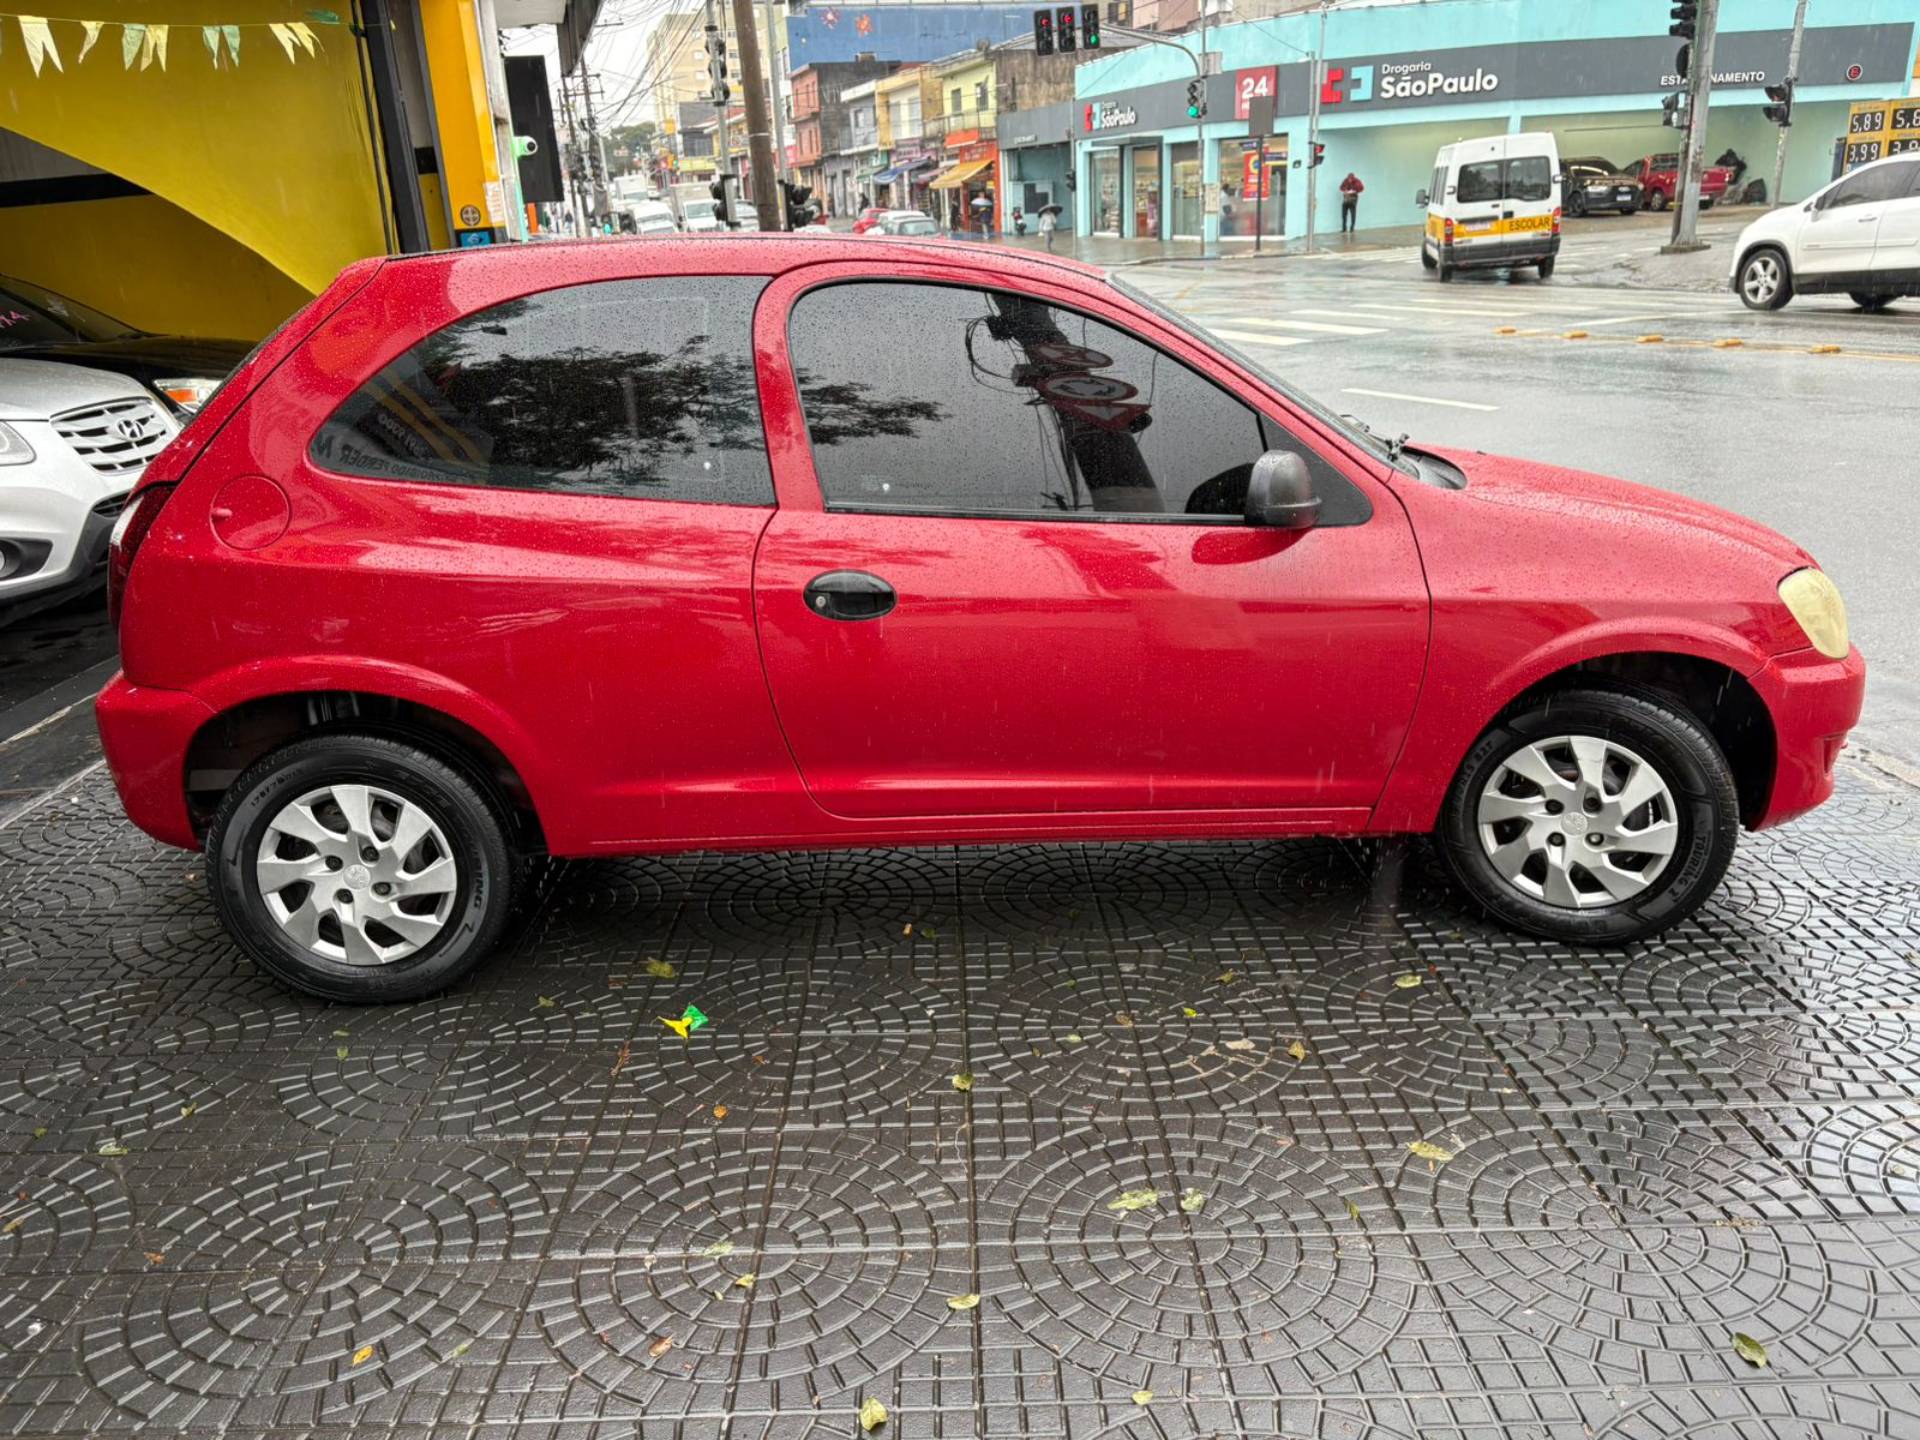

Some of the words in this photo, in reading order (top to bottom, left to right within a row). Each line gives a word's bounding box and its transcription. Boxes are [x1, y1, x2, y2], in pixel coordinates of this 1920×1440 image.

[1382, 61, 1432, 75] Drogaria
[1241, 75, 1268, 99] 24
[1380, 68, 1499, 98] SãoPaulo
[1852, 112, 1882, 133] 5,89
[1849, 143, 1879, 162] 3,99
[1509, 216, 1551, 231] ESCOLAR
[1679, 835, 1708, 887] TOURING
